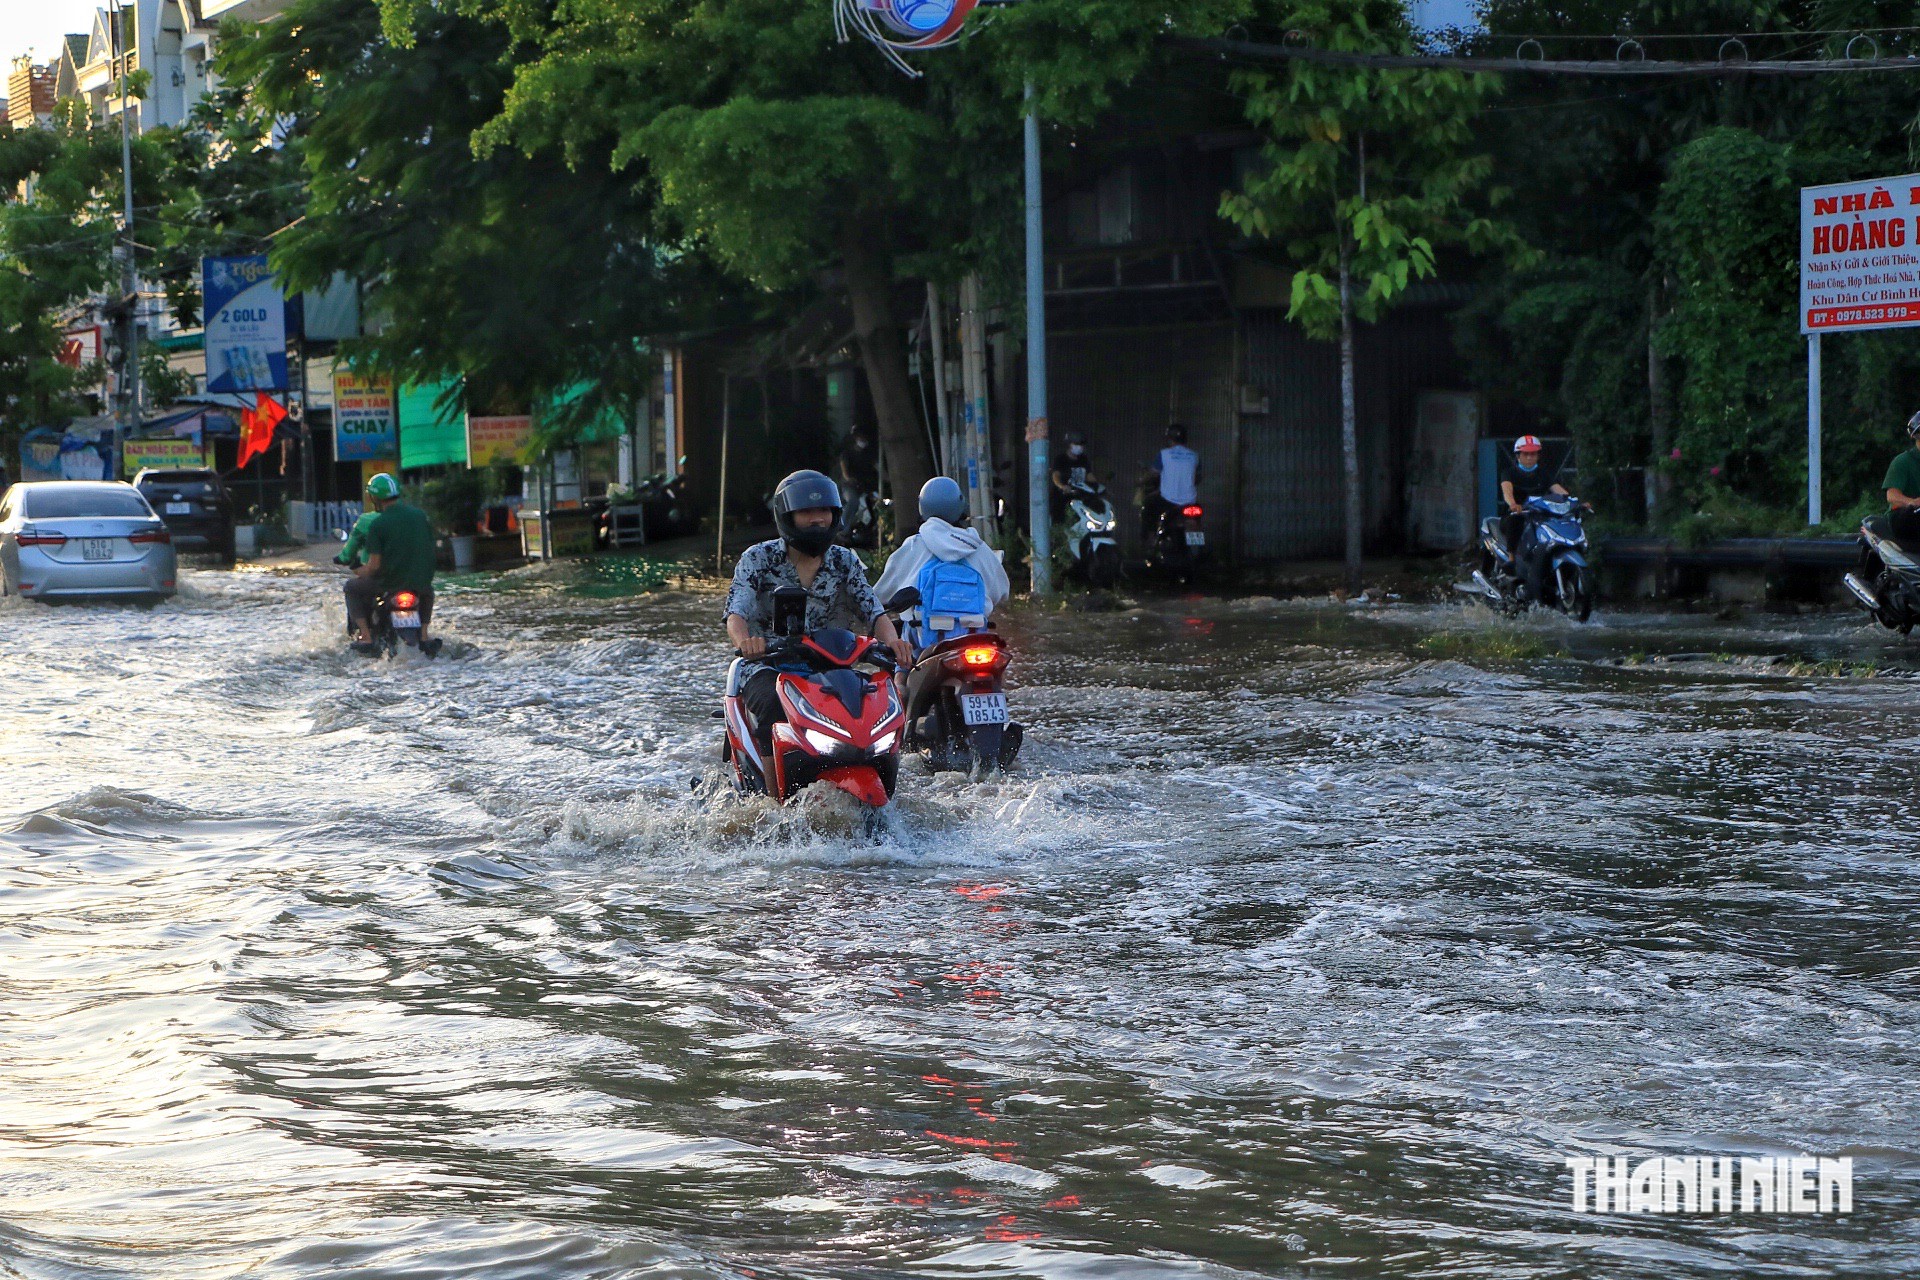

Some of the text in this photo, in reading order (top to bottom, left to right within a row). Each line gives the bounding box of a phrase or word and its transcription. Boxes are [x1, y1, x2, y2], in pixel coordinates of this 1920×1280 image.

[1813, 186, 1895, 216] NHÀ
[1812, 214, 1906, 255] HOÀNG
[1807, 262, 1829, 273] Nhận
[1862, 258, 1869, 268] &
[1892, 254, 1919, 266] Thiệu,
[1812, 294, 1834, 305] Khu
[1837, 293, 1859, 304] Dân
[1862, 291, 1878, 301] Cư
[1881, 289, 1906, 300] Bình
[221, 308, 267, 322] 2 GOLD
[1836, 309, 1885, 322] 0978.523
[1887, 307, 1907, 317] 979
[342, 418, 388, 434] CHAY
[969, 695, 1000, 709] 59-KA
[968, 708, 1005, 723] 185.43
